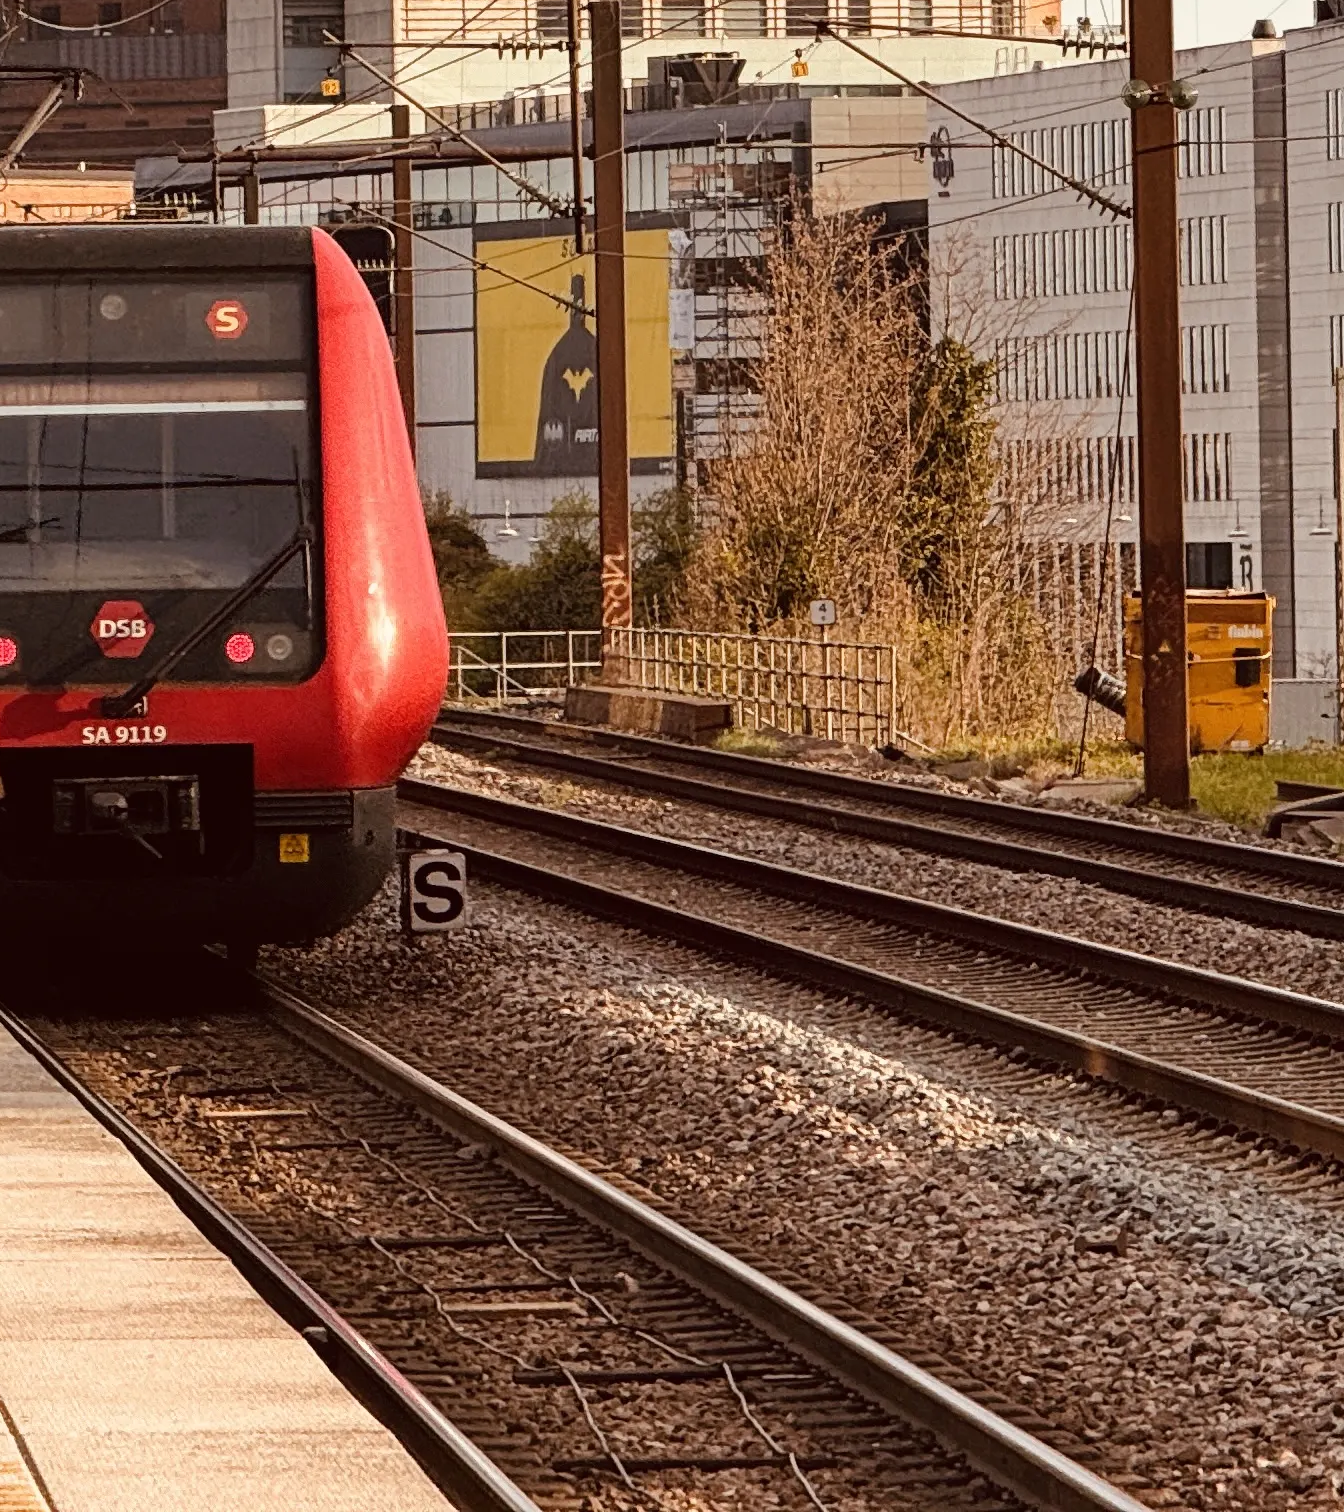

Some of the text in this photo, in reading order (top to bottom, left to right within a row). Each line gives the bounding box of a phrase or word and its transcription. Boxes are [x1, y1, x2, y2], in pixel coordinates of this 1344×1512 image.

[215, 306, 239, 332] S
[98, 619, 148, 639] DSB
[82, 725, 167, 745] SA 9119
[413, 861, 465, 924] S
